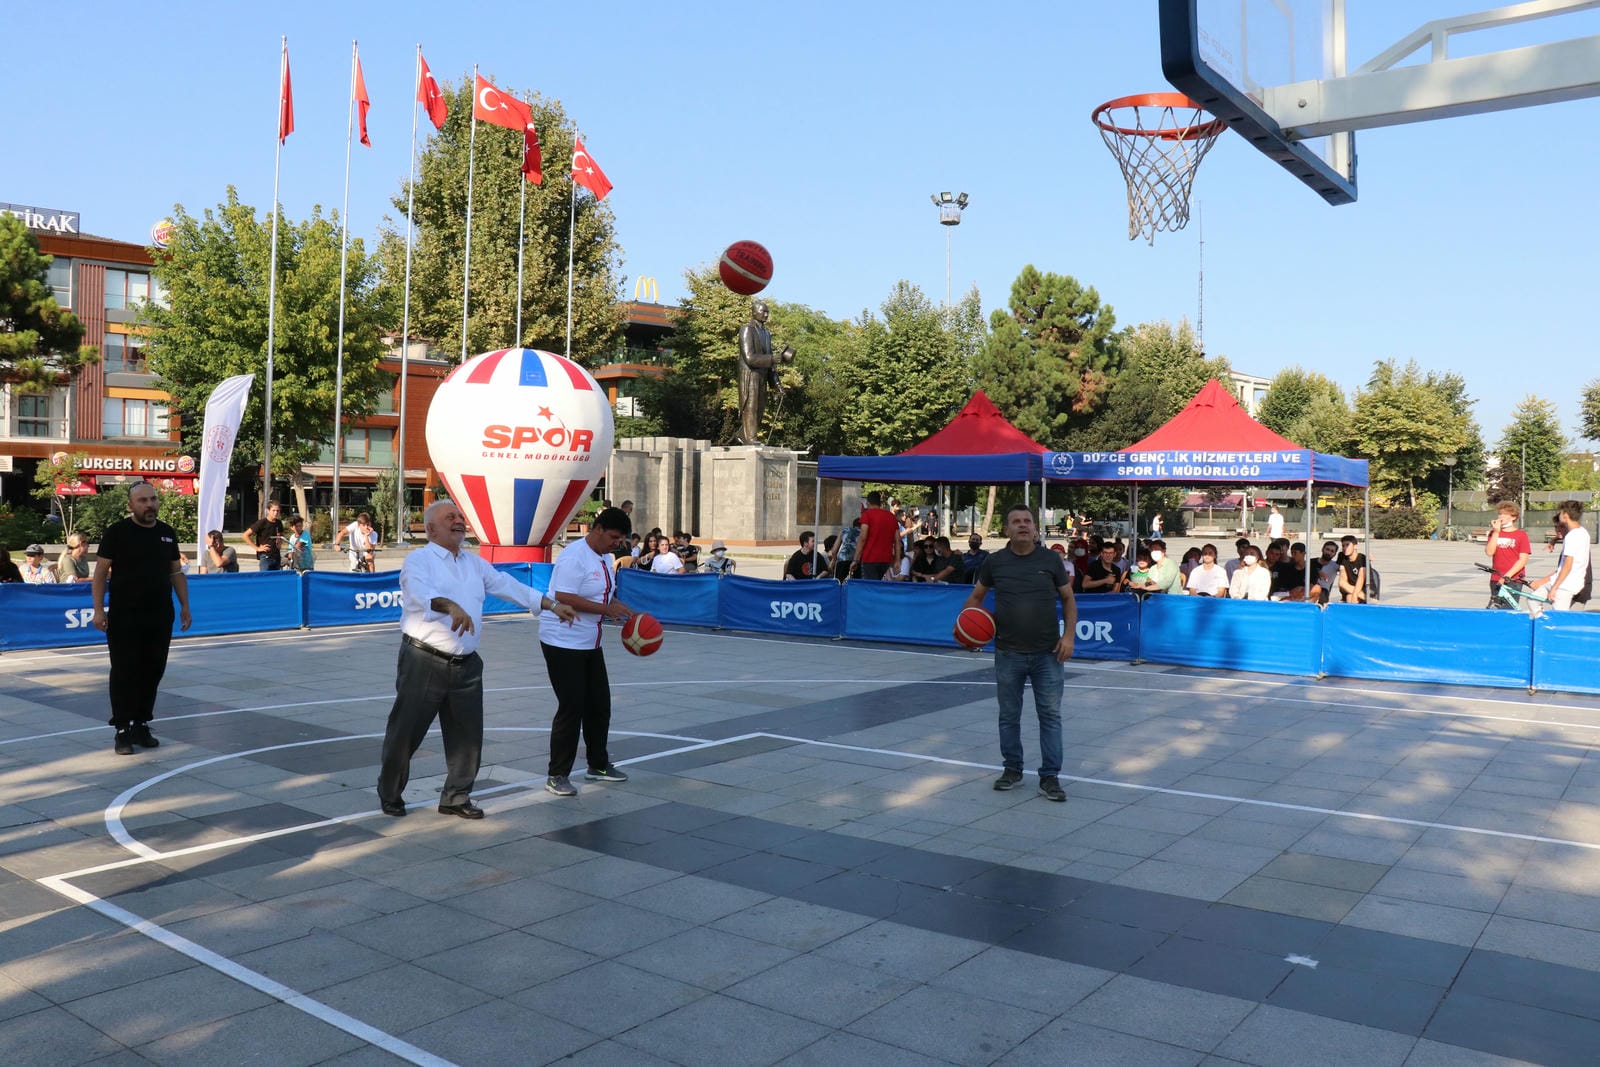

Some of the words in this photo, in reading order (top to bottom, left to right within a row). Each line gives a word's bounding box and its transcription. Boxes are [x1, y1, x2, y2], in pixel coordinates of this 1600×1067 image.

[482, 425, 593, 452] SPOR
[139, 459, 176, 471] KING
[1083, 452, 1126, 463] DÜZCE
[1130, 451, 1188, 465] GENÇLİK
[1192, 452, 1277, 463] HİZMETLERİ
[1281, 453, 1301, 463] VE
[1117, 466, 1153, 476] SPOR
[1156, 464, 1169, 476] İL
[1172, 465, 1260, 476] MÜDÜRLÜĞÜ
[65, 607, 109, 629] SP
[770, 601, 823, 623] SPOR
[1059, 620, 1115, 644] OR
